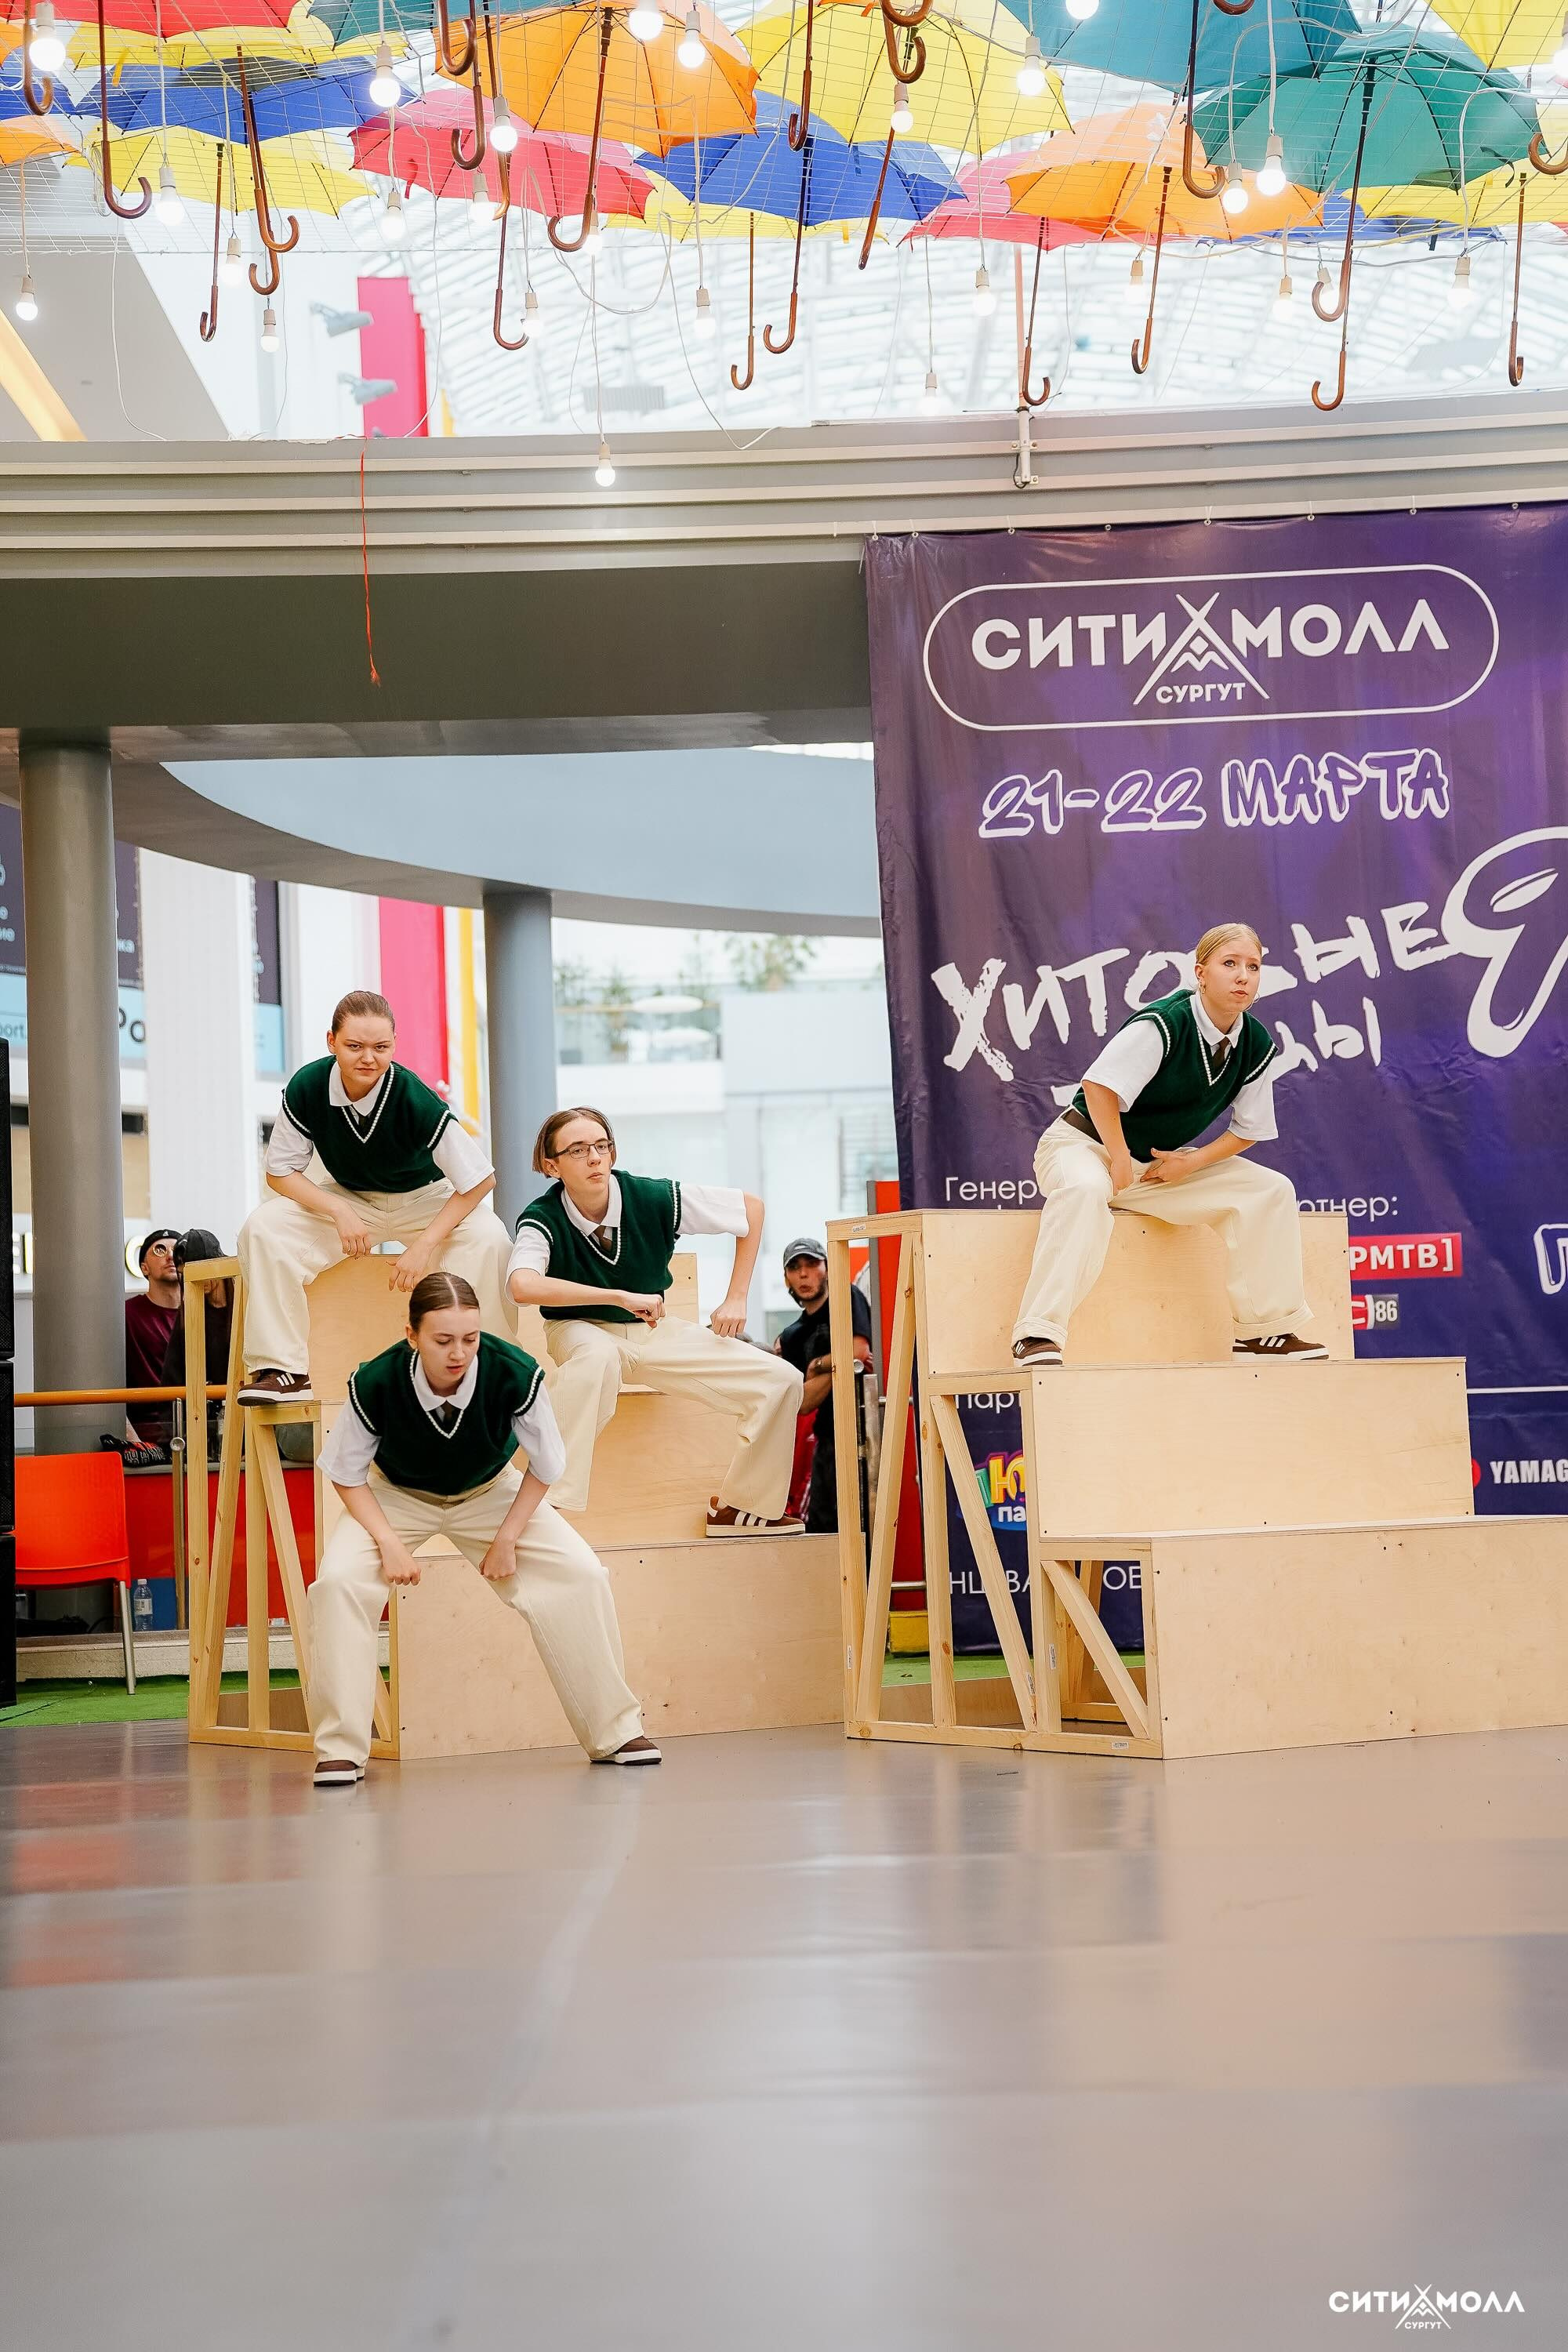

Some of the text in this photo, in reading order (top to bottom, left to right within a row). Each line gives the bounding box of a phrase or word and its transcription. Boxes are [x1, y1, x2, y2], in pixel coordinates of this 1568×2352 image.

[971, 598, 1449, 670] СИТИ МОЛЛ
[1155, 681, 1247, 704] СУРГУТ
[978, 747, 1450, 839] 21-22 МАРТА
[1348, 1237, 1454, 1272] РМТВ]
